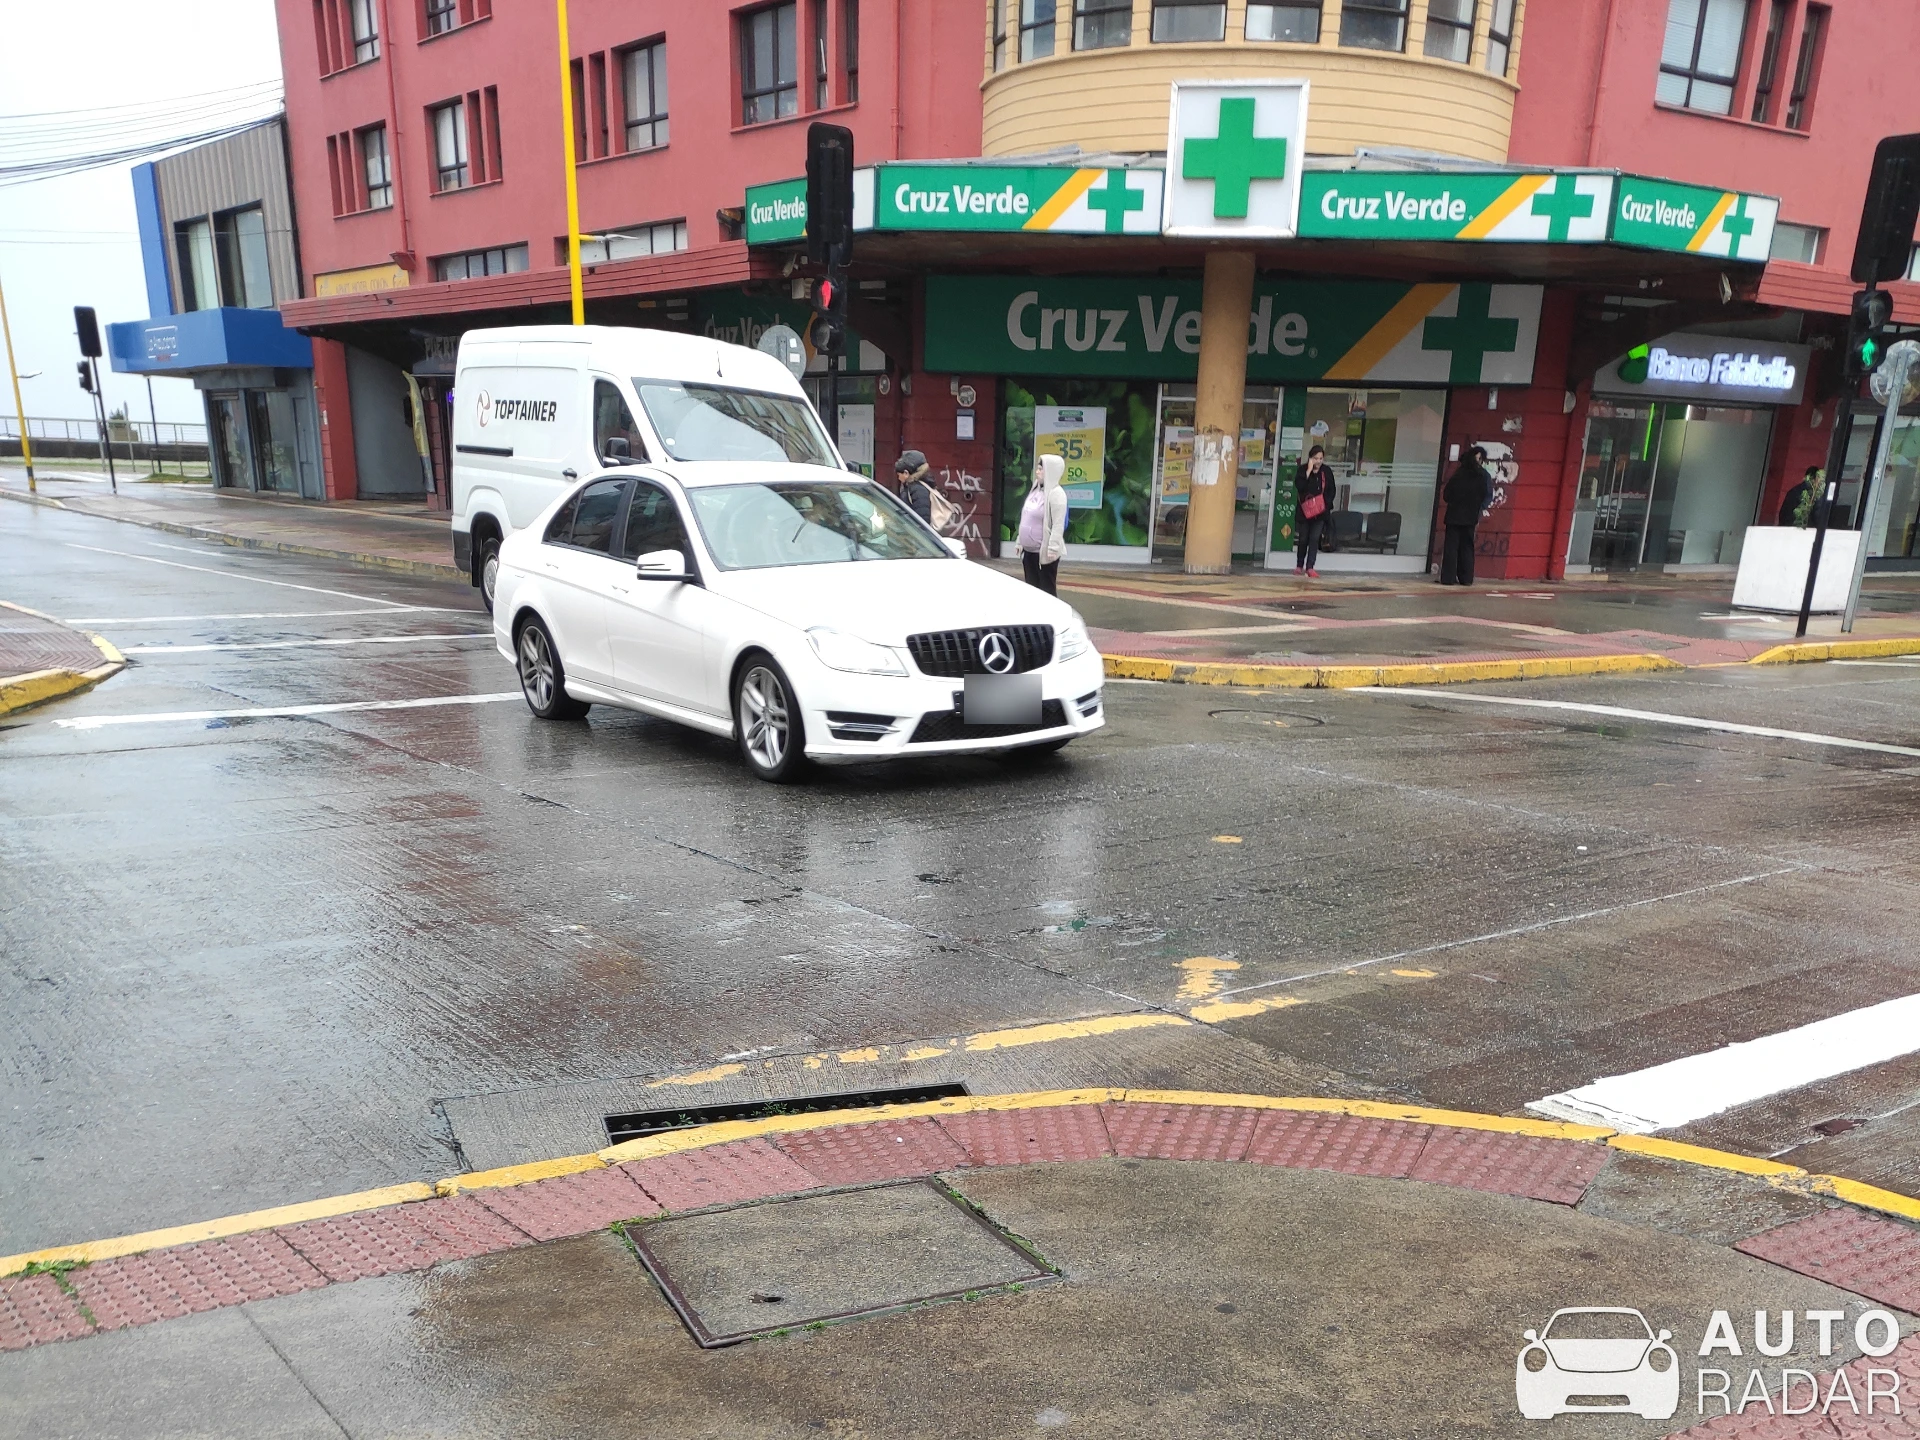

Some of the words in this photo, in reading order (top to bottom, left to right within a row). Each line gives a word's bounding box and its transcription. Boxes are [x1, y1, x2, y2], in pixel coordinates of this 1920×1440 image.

[750, 202, 774, 225] Cruz
[773, 196, 806, 221] Verde
[894, 183, 950, 213] Cruz
[953, 184, 1030, 214] Verde
[1321, 188, 1382, 221] Cruz
[1384, 190, 1467, 222] Verde
[1621, 194, 1653, 223] Cruz
[1654, 198, 1697, 229] Verde
[1006, 291, 1130, 352] Cruz
[1136, 295, 1309, 357] Vede
[1647, 347, 1710, 384] Banco
[1709, 352, 1796, 390] Falabella
[494, 399, 557, 422] TOPTAINER
